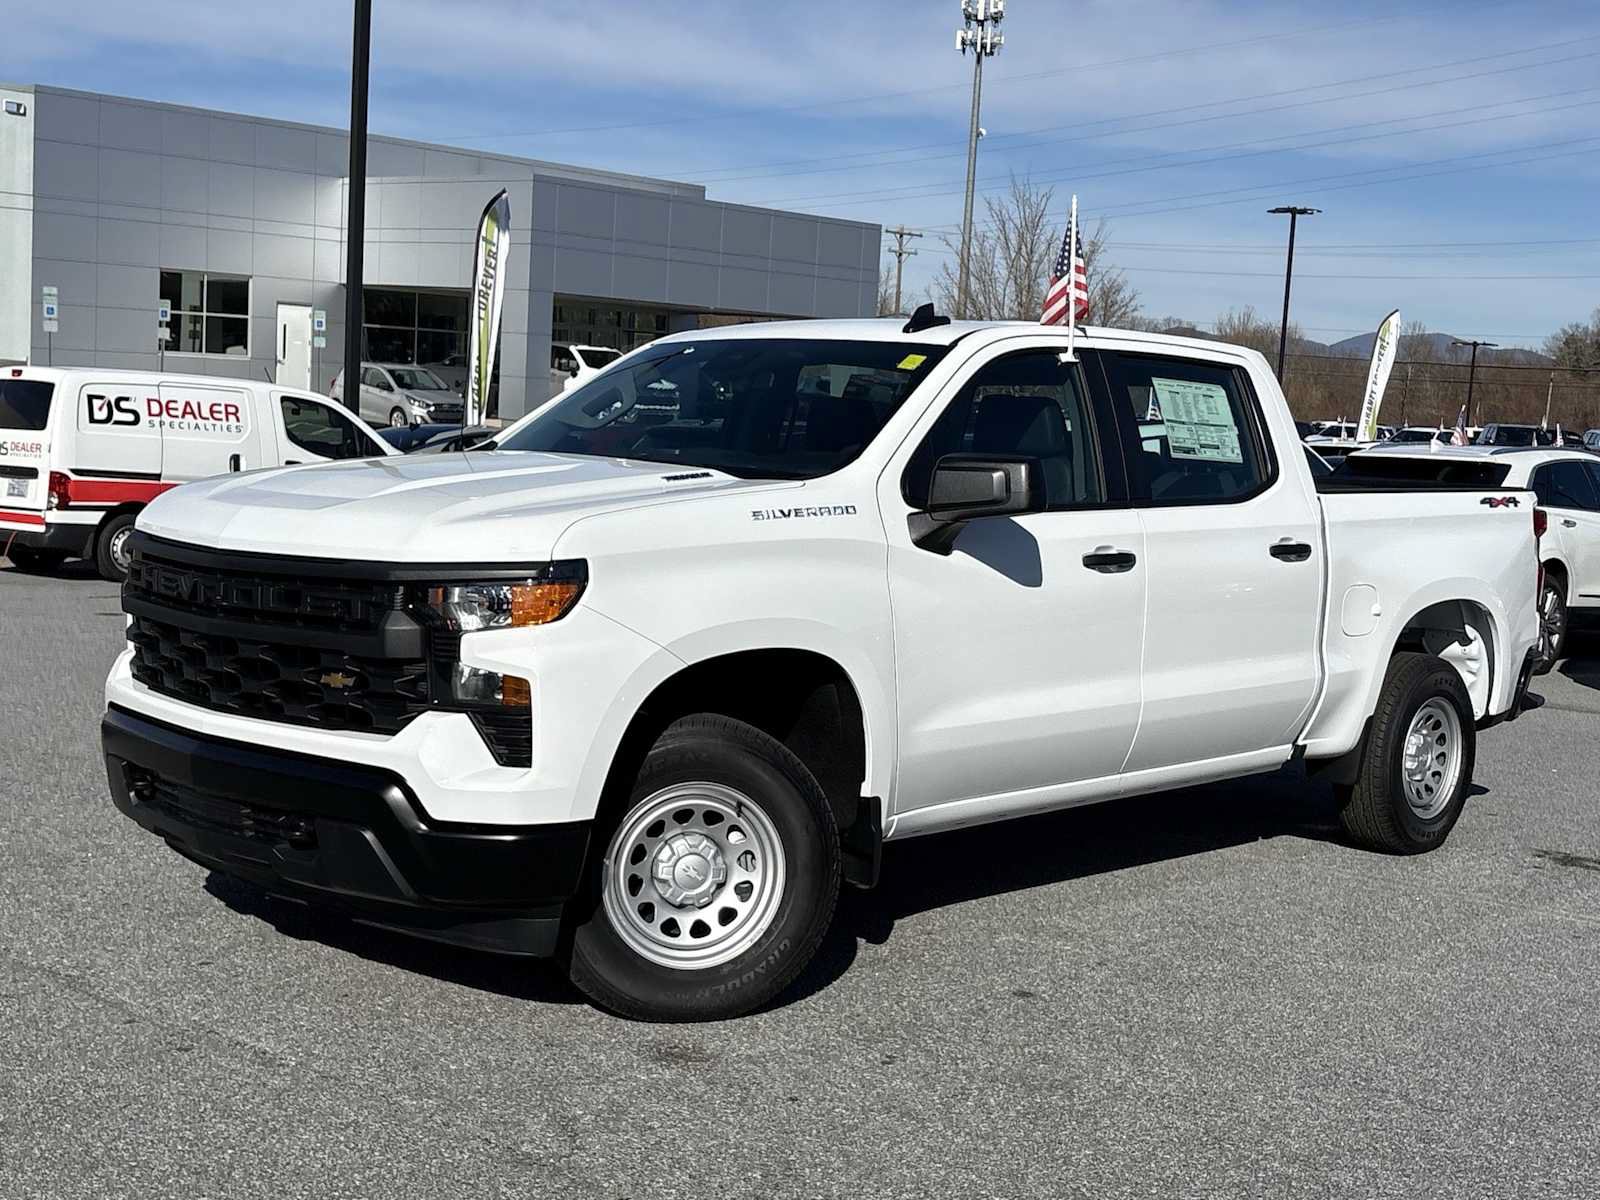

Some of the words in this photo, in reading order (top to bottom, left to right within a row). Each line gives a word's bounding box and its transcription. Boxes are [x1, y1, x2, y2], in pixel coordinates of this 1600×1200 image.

[87, 393, 140, 427] DS
[146, 398, 241, 424] DEALER
[148, 420, 244, 434] SPECIALTIES
[10, 441, 42, 453] DEALER
[751, 505, 857, 521] SILVERADO
